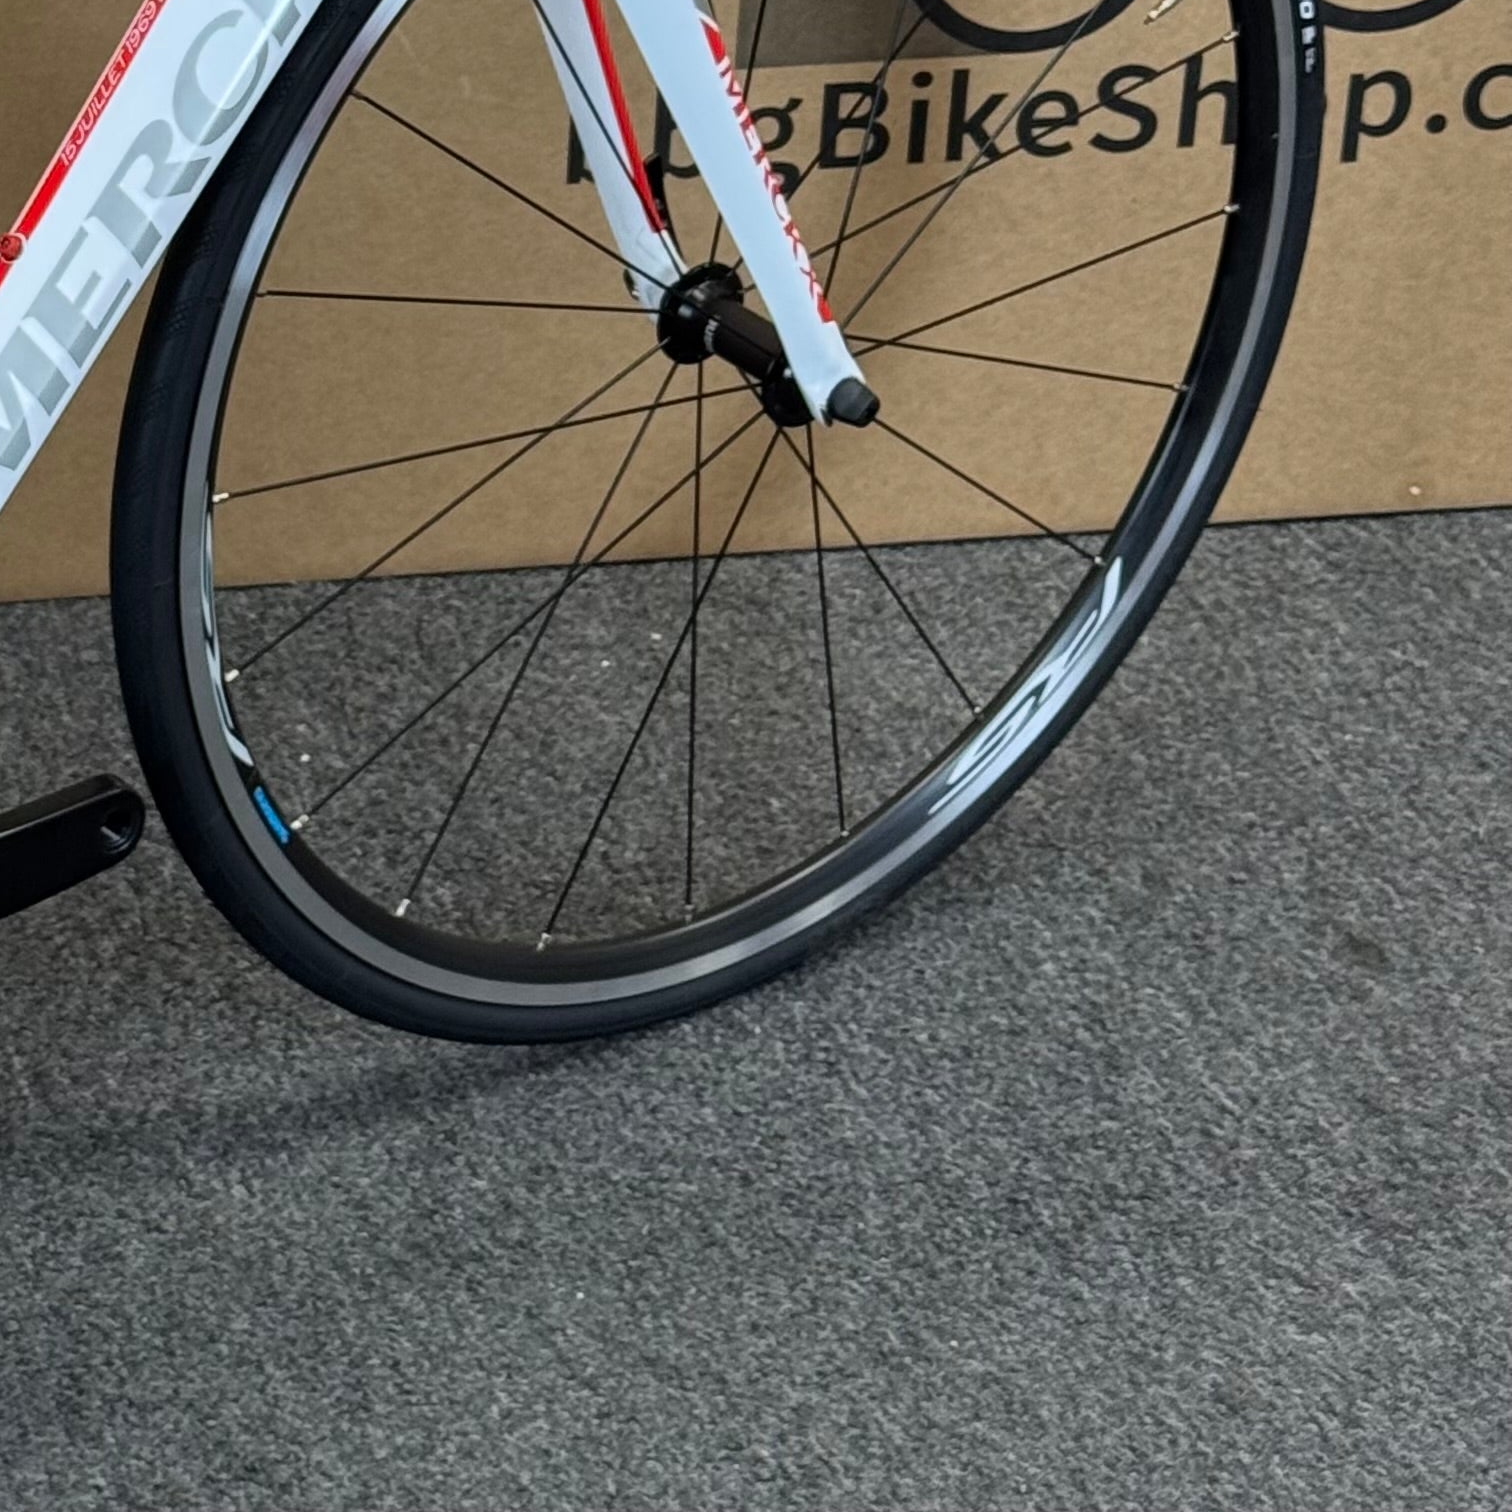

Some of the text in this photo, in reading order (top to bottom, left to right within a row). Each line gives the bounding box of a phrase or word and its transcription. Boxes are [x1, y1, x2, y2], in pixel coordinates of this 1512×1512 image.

[59, 142, 78, 167] 15
[74, 51, 129, 147] JUILLET
[124, 0, 158, 54] 1969
